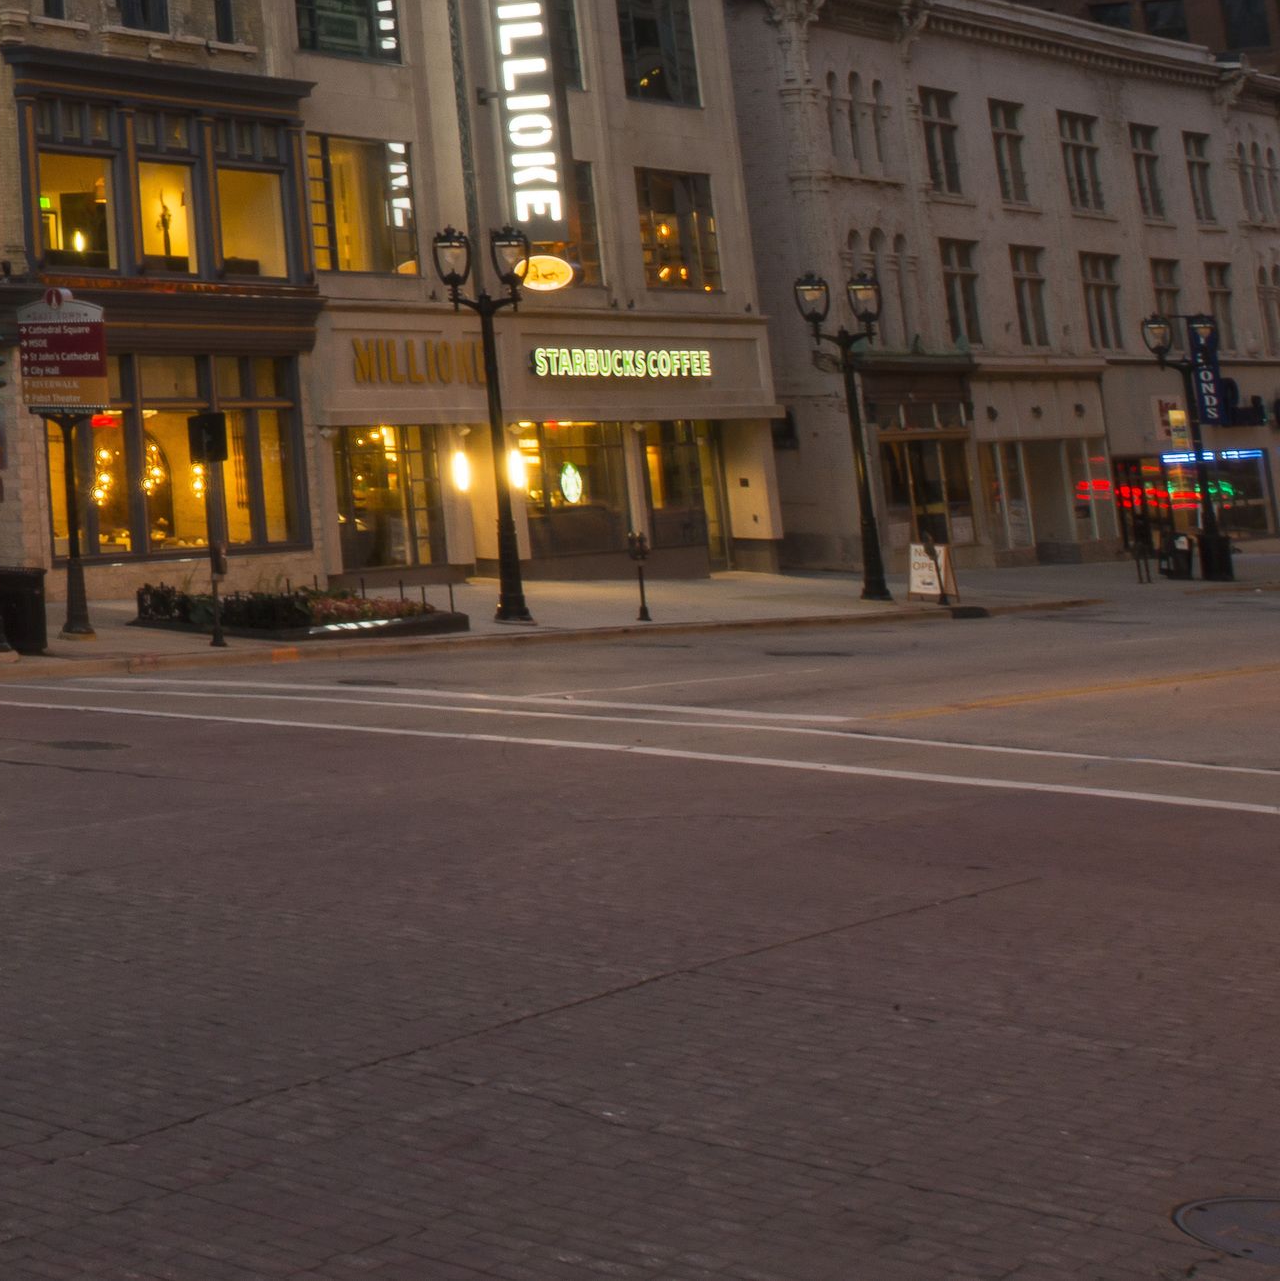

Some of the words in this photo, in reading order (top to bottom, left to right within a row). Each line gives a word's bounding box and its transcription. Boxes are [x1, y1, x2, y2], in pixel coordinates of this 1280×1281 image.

[28, 325, 61, 335] Cathedral
[63, 325, 91, 336] Square
[61, 352, 100, 361] Cathedral
[534, 347, 646, 378] STARBUCKS
[646, 349, 712, 378] COFFEE
[31, 365, 44, 376] City
[45, 366, 60, 375] Hall
